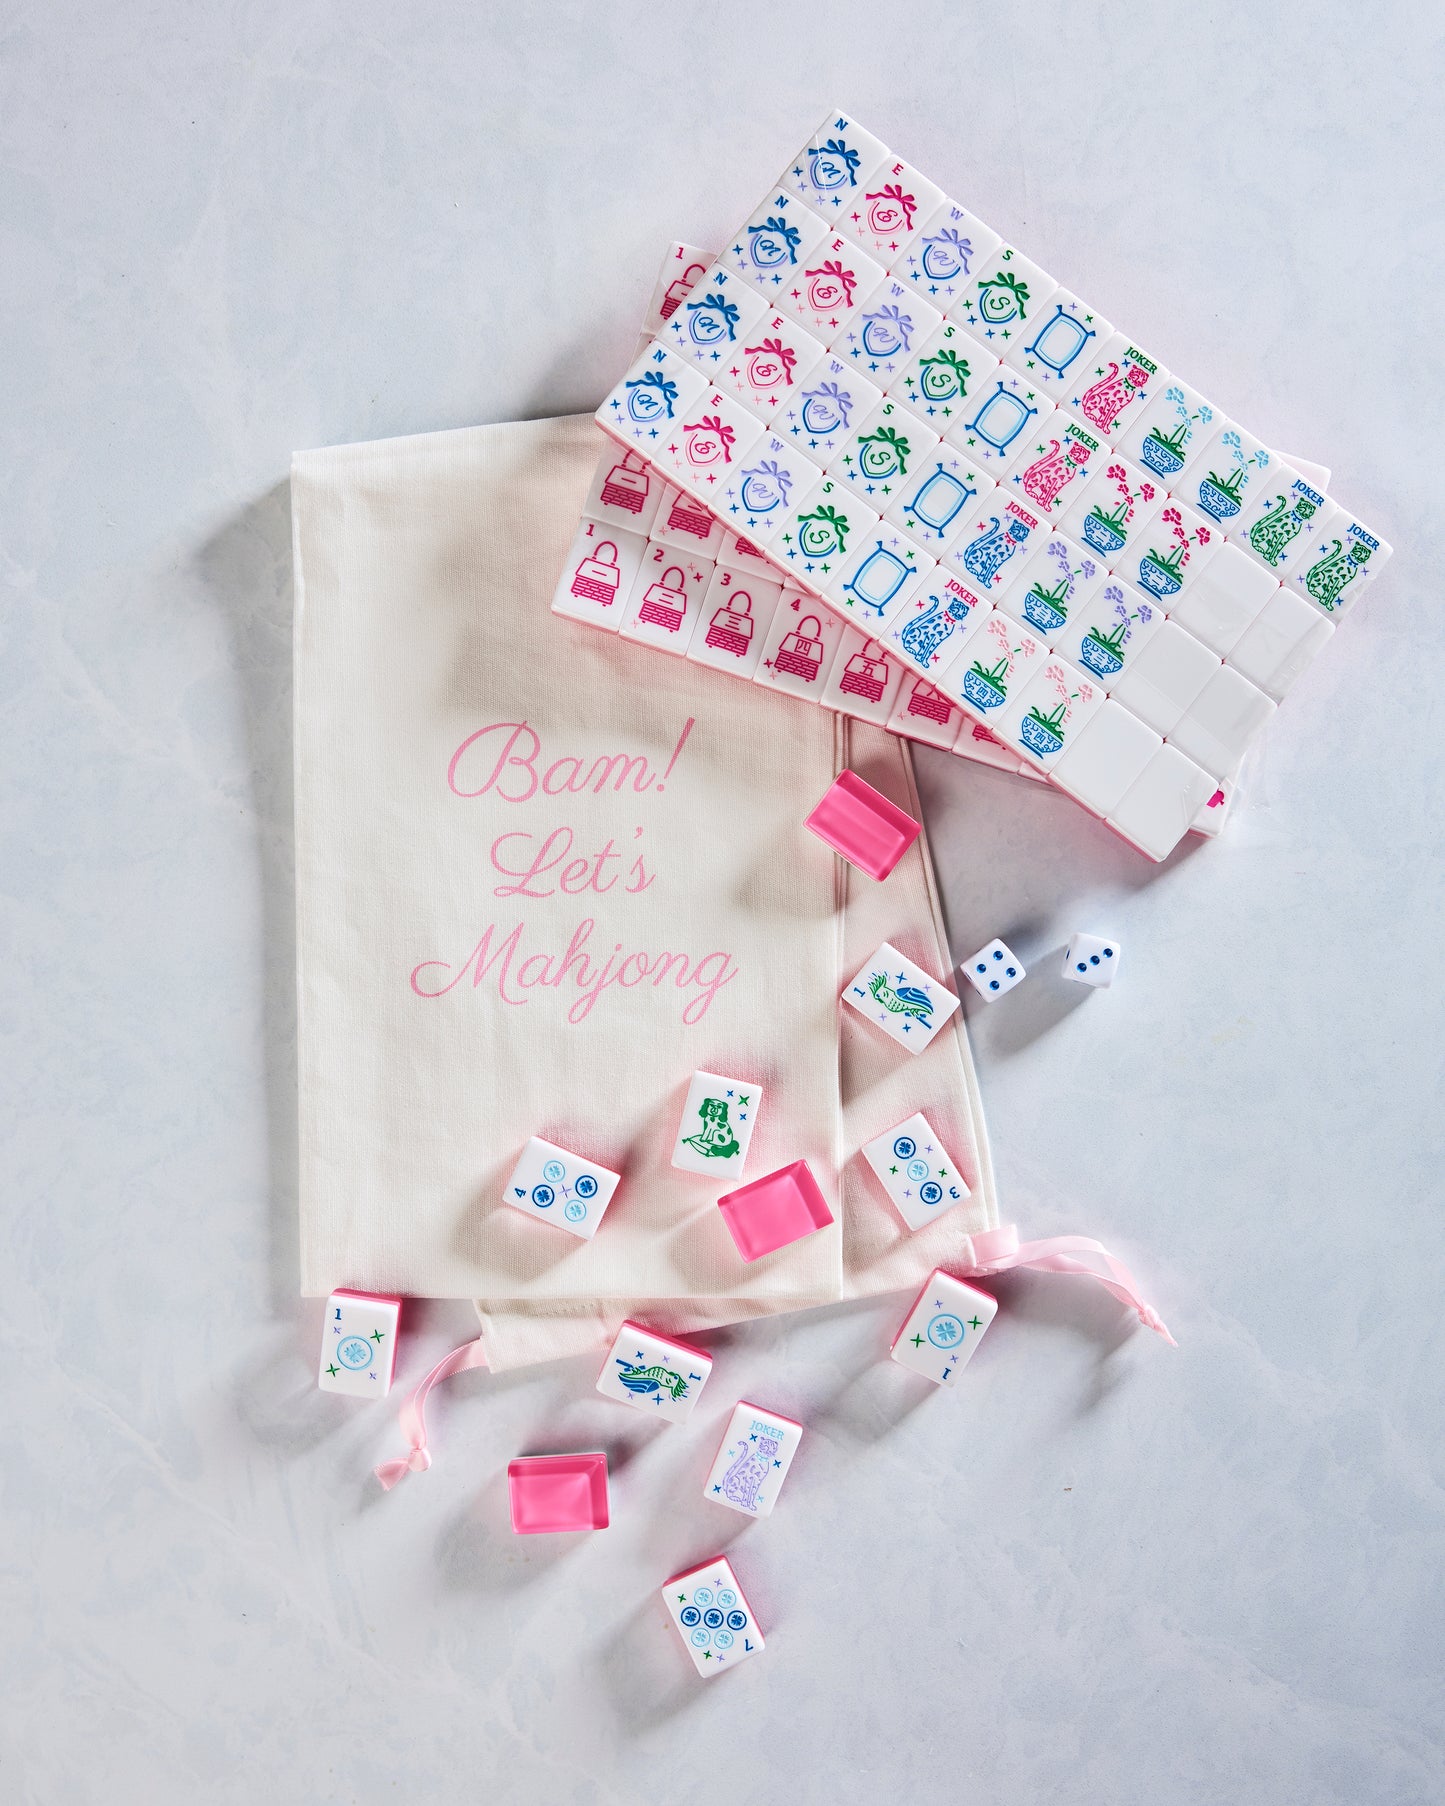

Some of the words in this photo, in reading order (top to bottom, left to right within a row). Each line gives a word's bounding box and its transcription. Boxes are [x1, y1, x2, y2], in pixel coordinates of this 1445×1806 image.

[835, 118, 848, 131] N
[892, 163, 903, 175] E
[775, 195, 789, 208] N
[951, 207, 964, 220] W
[832, 239, 844, 251] E
[676, 247, 683, 259] 1
[1002, 250, 1013, 260] S
[714, 272, 728, 285] N
[891, 283, 904, 296] W
[771, 317, 783, 329] E
[944, 327, 955, 337] S
[653, 350, 667, 363] N
[1124, 346, 1159, 374] JOKER
[830, 360, 843, 373] W
[711, 394, 722, 406] E
[883, 404, 894, 414] S
[1065, 423, 1099, 452] JOKER
[771, 438, 784, 451] W
[823, 482, 834, 493] S
[1292, 479, 1325, 507] JOKER
[1005, 501, 1038, 529] JOKER
[586, 524, 594, 536] 1
[1348, 523, 1380, 551] JOKER
[654, 549, 664, 562] 2
[721, 573, 731, 586] 3
[945, 579, 979, 607] JOKER
[791, 599, 800, 611] 4
[794, 639, 811, 656] 四
[859, 660, 877, 678] 五
[448, 717, 695, 803] Bam!
[491, 827, 656, 898] Let's
[409, 918, 739, 1025] Mahjong
[854, 987, 865, 997] 1
[515, 1188, 526, 1198] 4
[950, 1187, 960, 1198] 3
[335, 1309, 341, 1320] 1
[943, 1368, 951, 1379] 1
[750, 1420, 784, 1440] JOKER
[745, 1639, 753, 1651] 7
